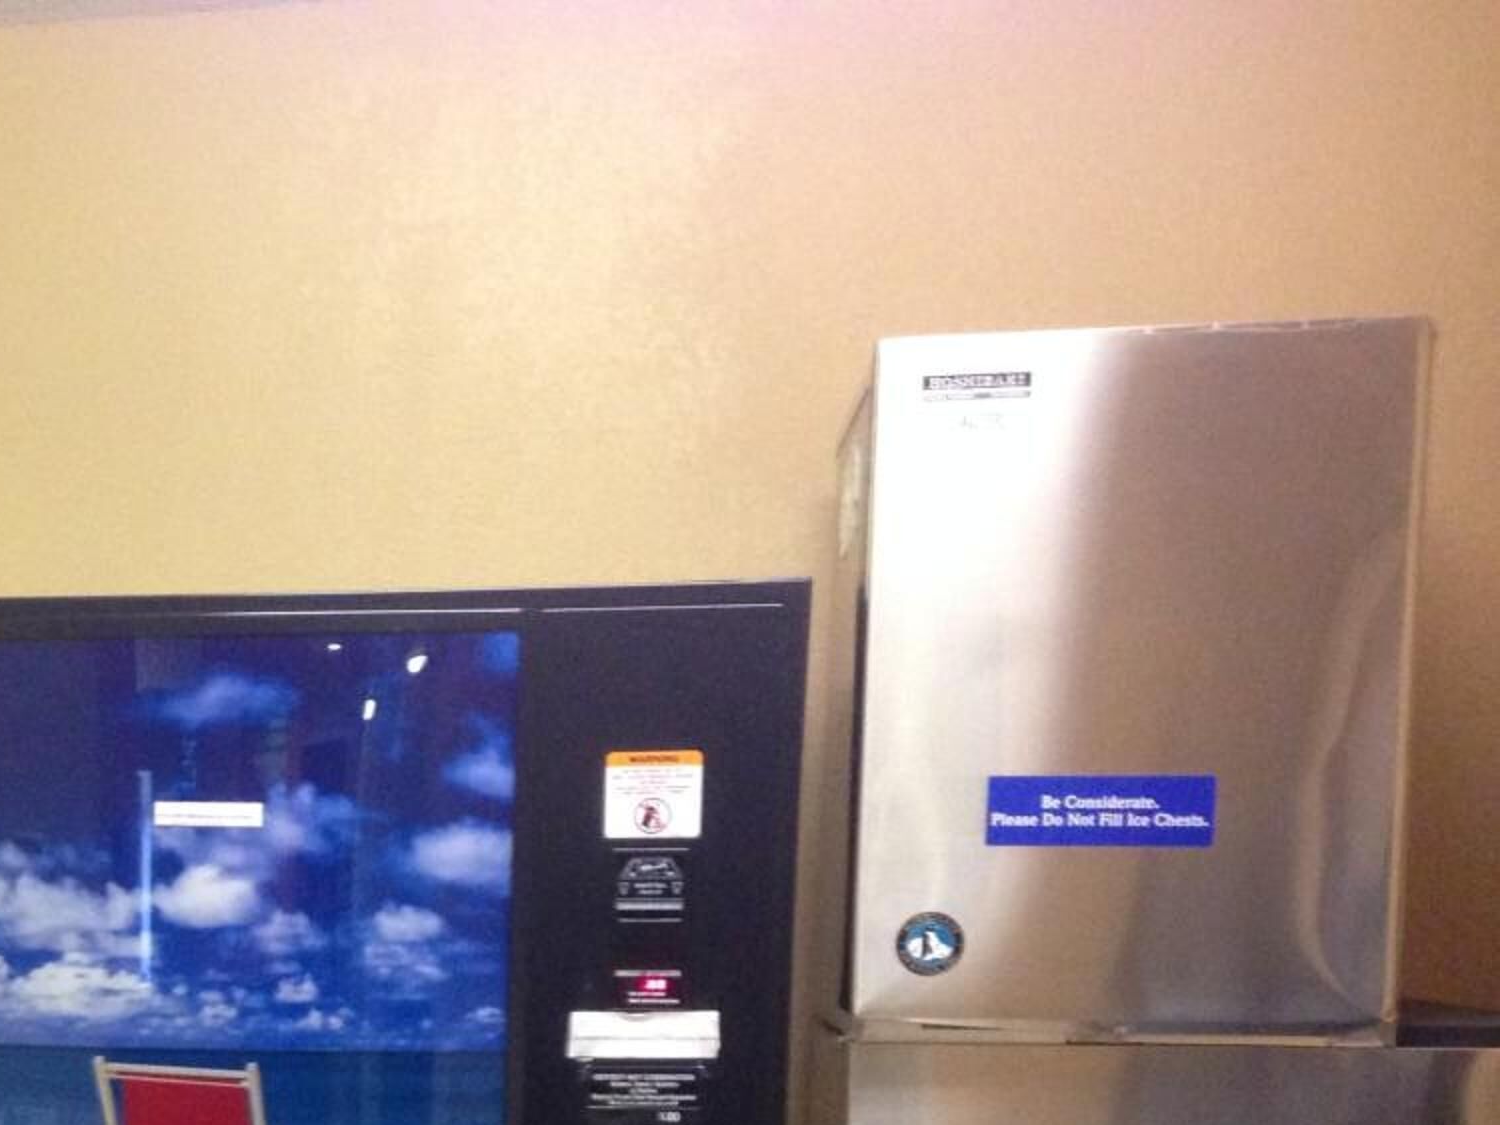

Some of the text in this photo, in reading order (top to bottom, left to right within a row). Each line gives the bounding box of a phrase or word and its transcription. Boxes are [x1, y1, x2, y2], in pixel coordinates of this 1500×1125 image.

[1041, 795, 1160, 810] Be Considerate.
[990, 812, 1039, 827] Please
[1042, 813, 1064, 827] Do
[1067, 813, 1096, 827] Not
[1099, 813, 1123, 827] Fill
[1127, 813, 1150, 827] Ice
